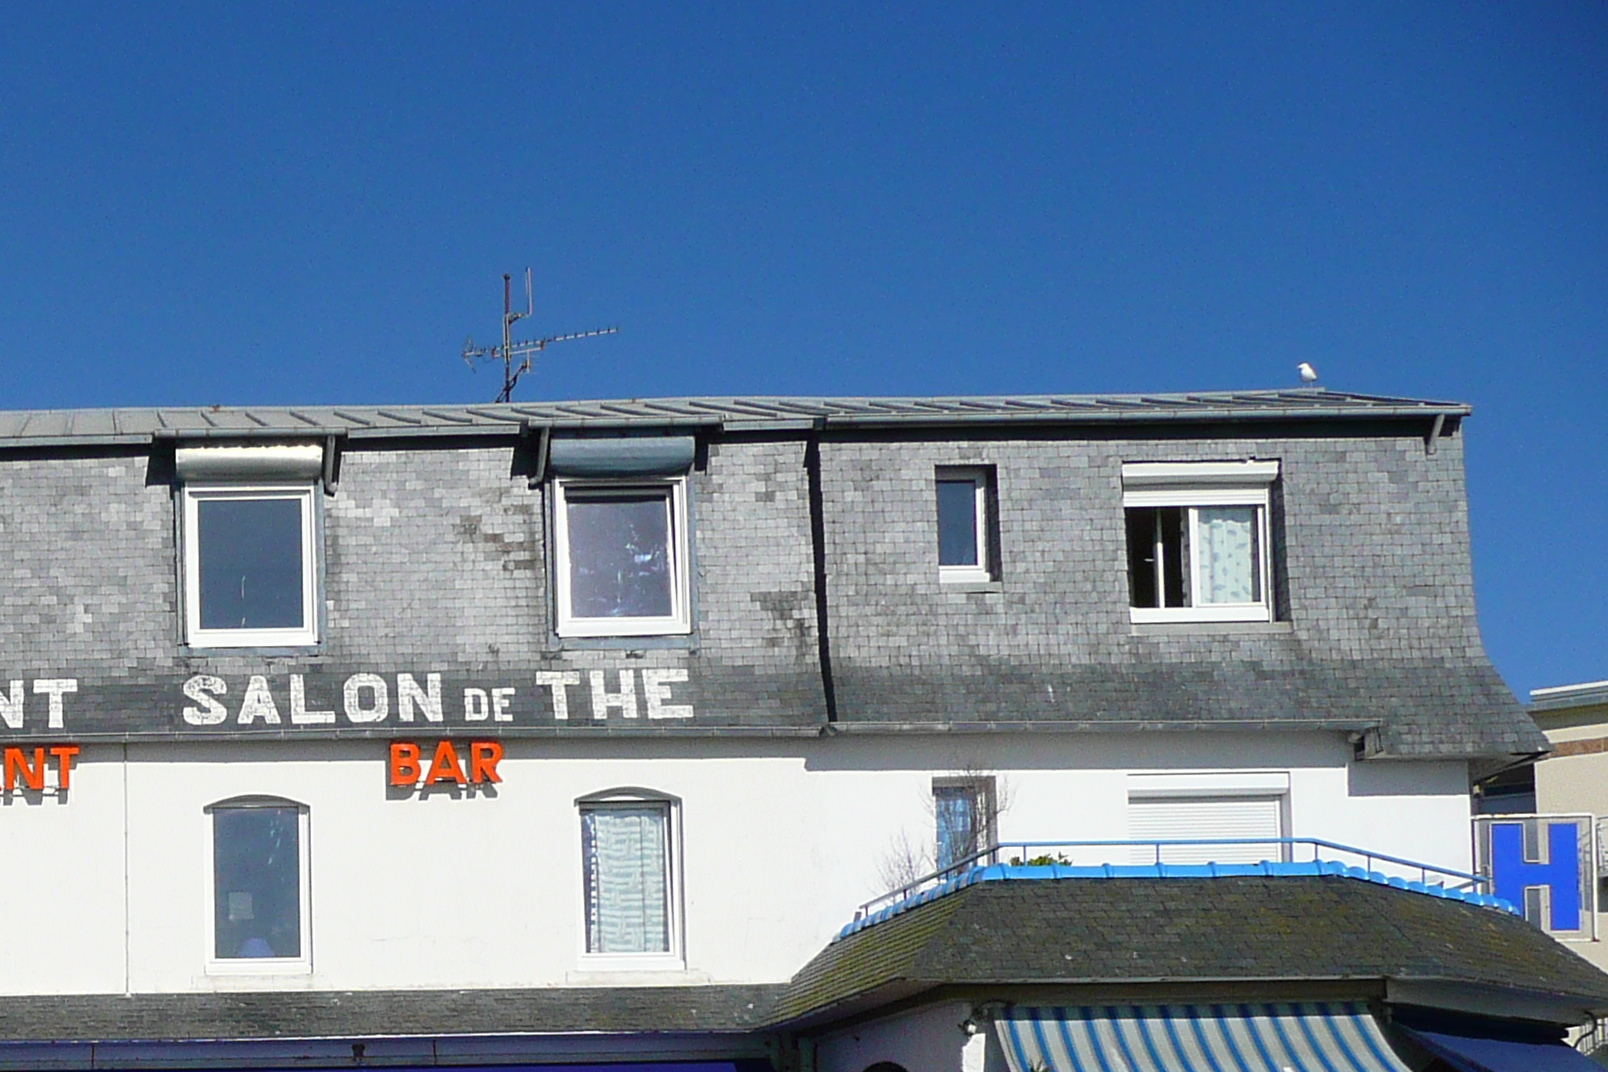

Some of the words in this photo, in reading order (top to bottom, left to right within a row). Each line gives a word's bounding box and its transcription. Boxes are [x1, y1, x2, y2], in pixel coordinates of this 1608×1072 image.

[182, 672, 444, 725] SALON
[464, 687, 516, 722] DE
[536, 668, 694, 720] THE
[390, 741, 503, 786] BAR
[1491, 822, 1581, 932] H
